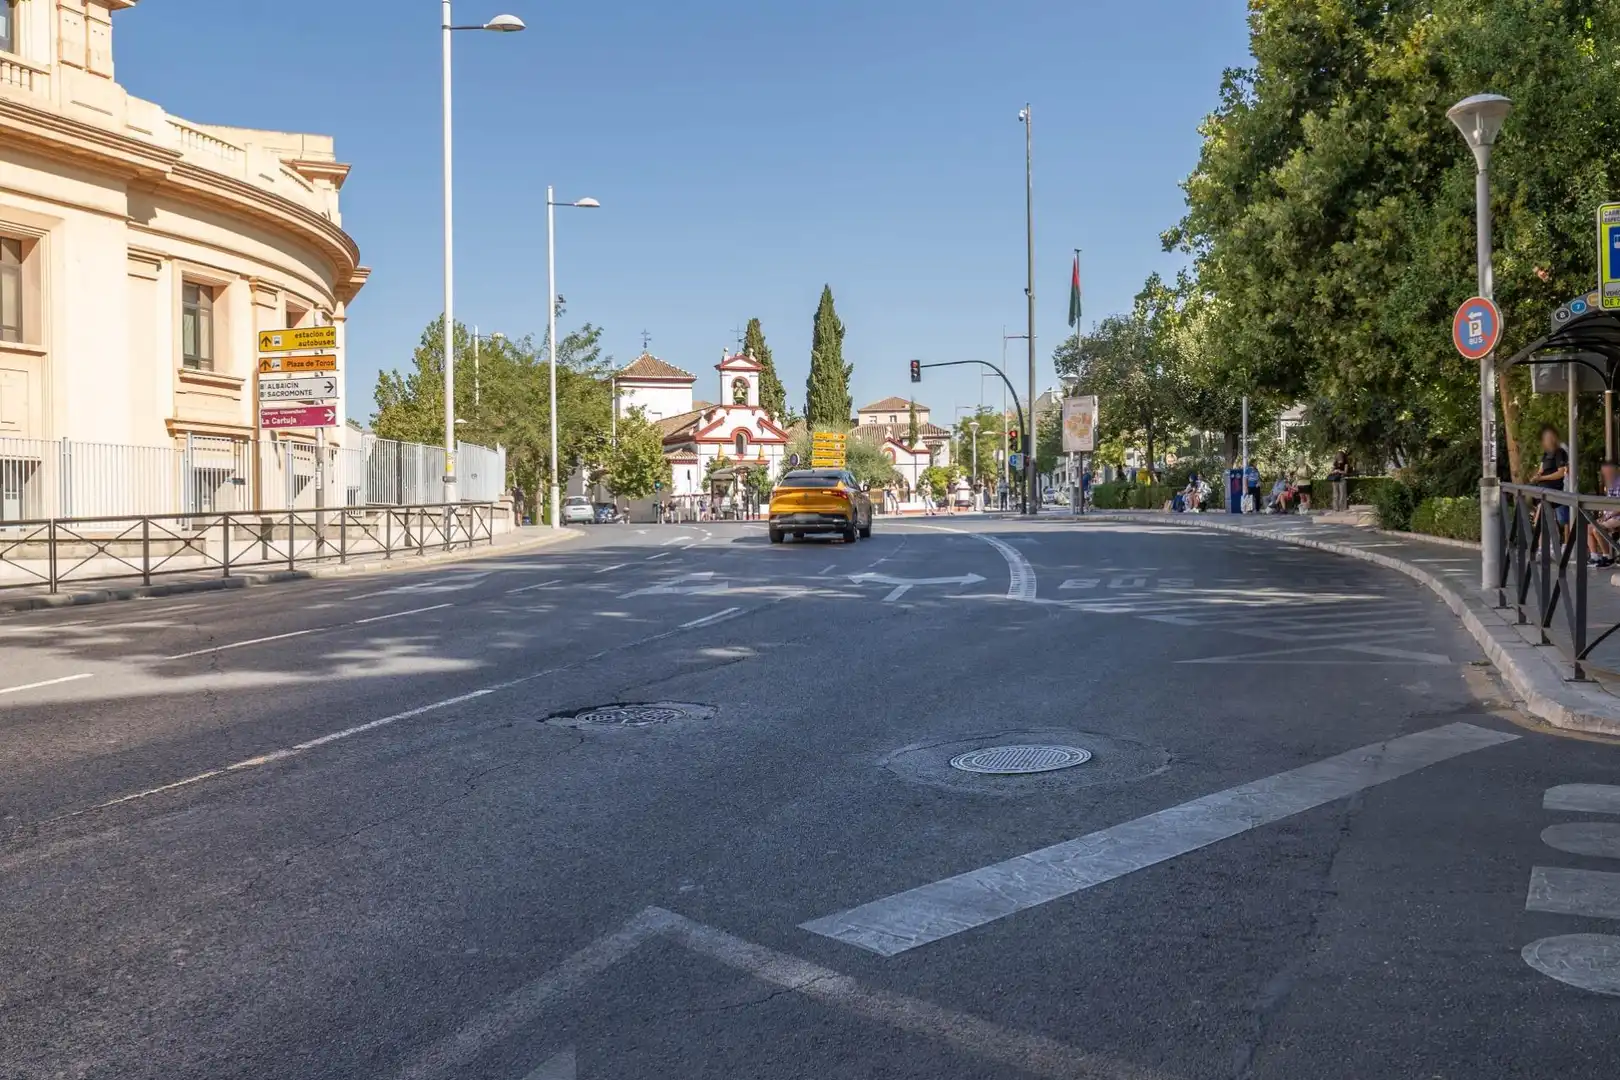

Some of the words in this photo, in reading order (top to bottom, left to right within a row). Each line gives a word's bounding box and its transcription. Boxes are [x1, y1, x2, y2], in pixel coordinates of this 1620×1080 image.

[1605, 298, 1614, 306] DE
[1471, 322, 1479, 335] P
[298, 339, 335, 347] autobuses
[1469, 335, 1483, 345] BUS
[315, 359, 334, 367] Toros
[267, 389, 312, 398] SACROMONTE
[271, 416, 297, 425] Cartuja
[1058, 578, 1195, 589] BUS
